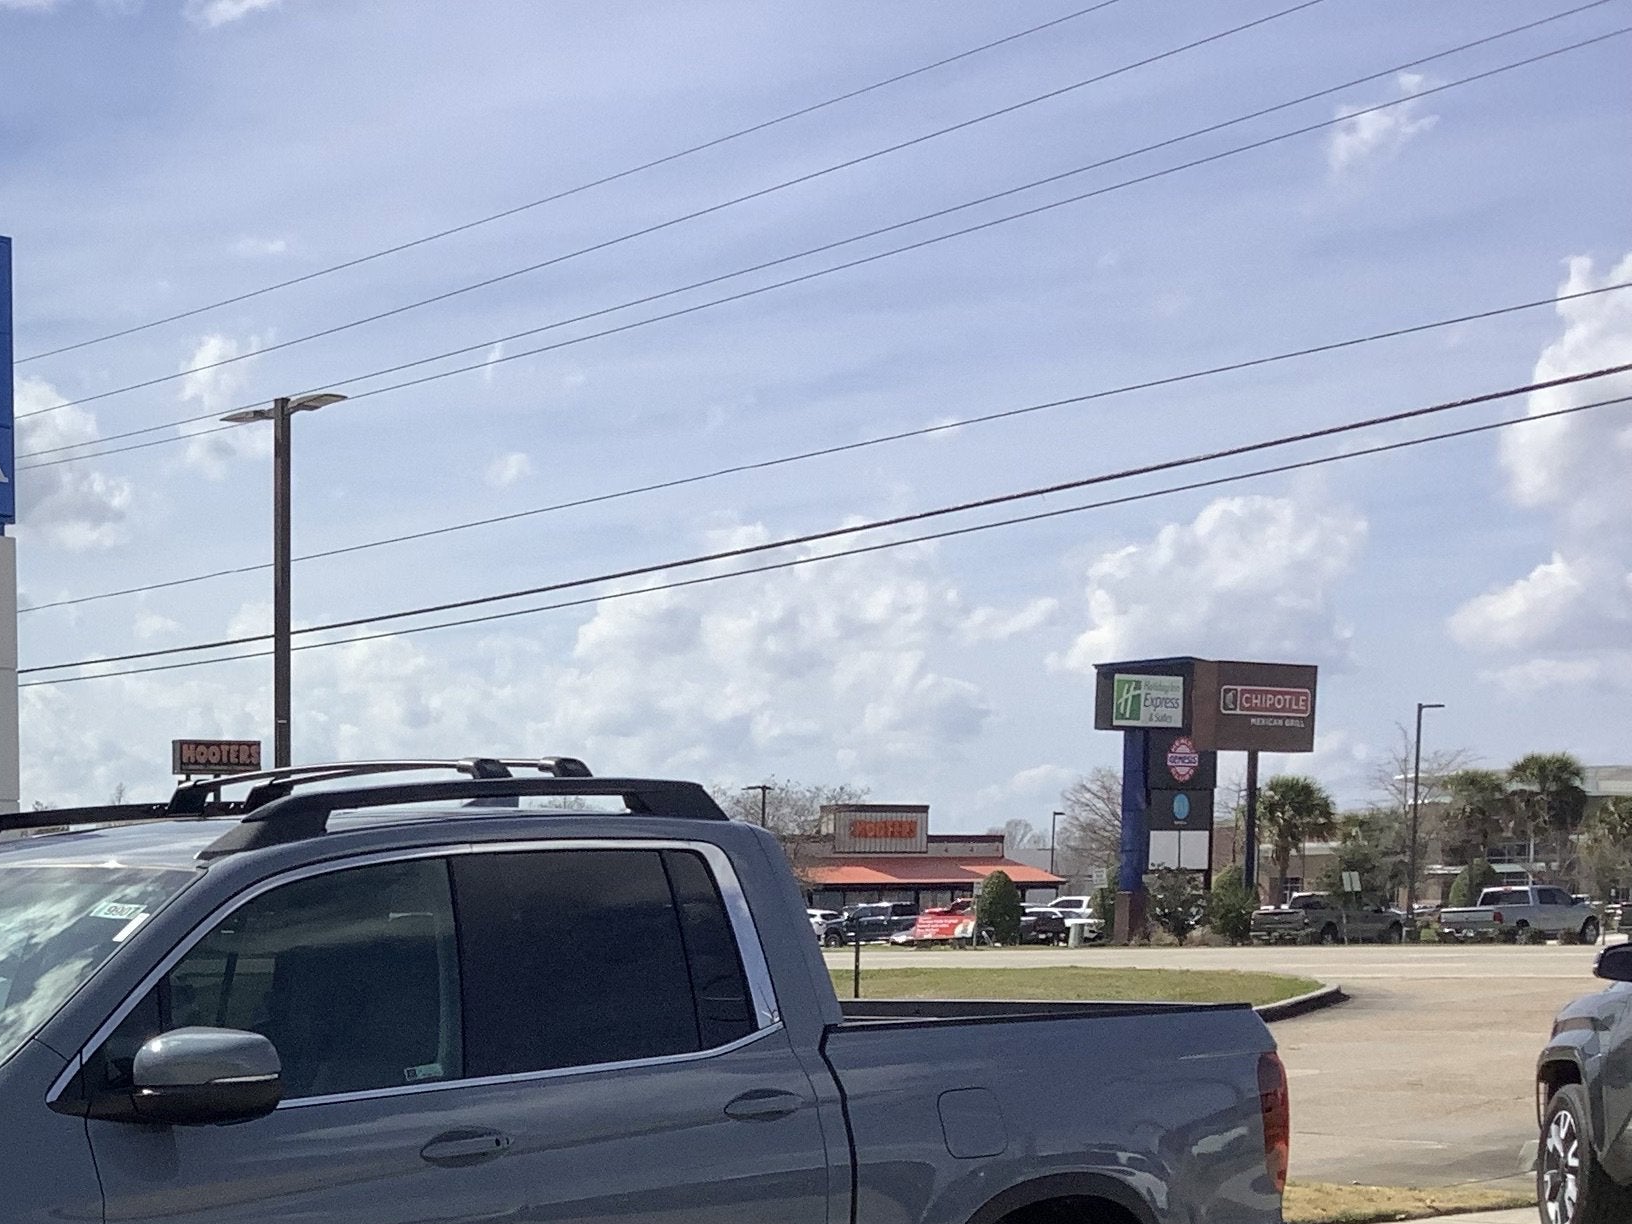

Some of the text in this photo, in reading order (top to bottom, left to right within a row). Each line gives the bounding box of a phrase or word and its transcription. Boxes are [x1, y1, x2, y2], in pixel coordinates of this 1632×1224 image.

[1144, 692, 1180, 711] Express
[1241, 693, 1307, 710] CHIPOTLE
[1250, 717, 1284, 726] MEXICAN
[181, 743, 259, 764] HOOTERS
